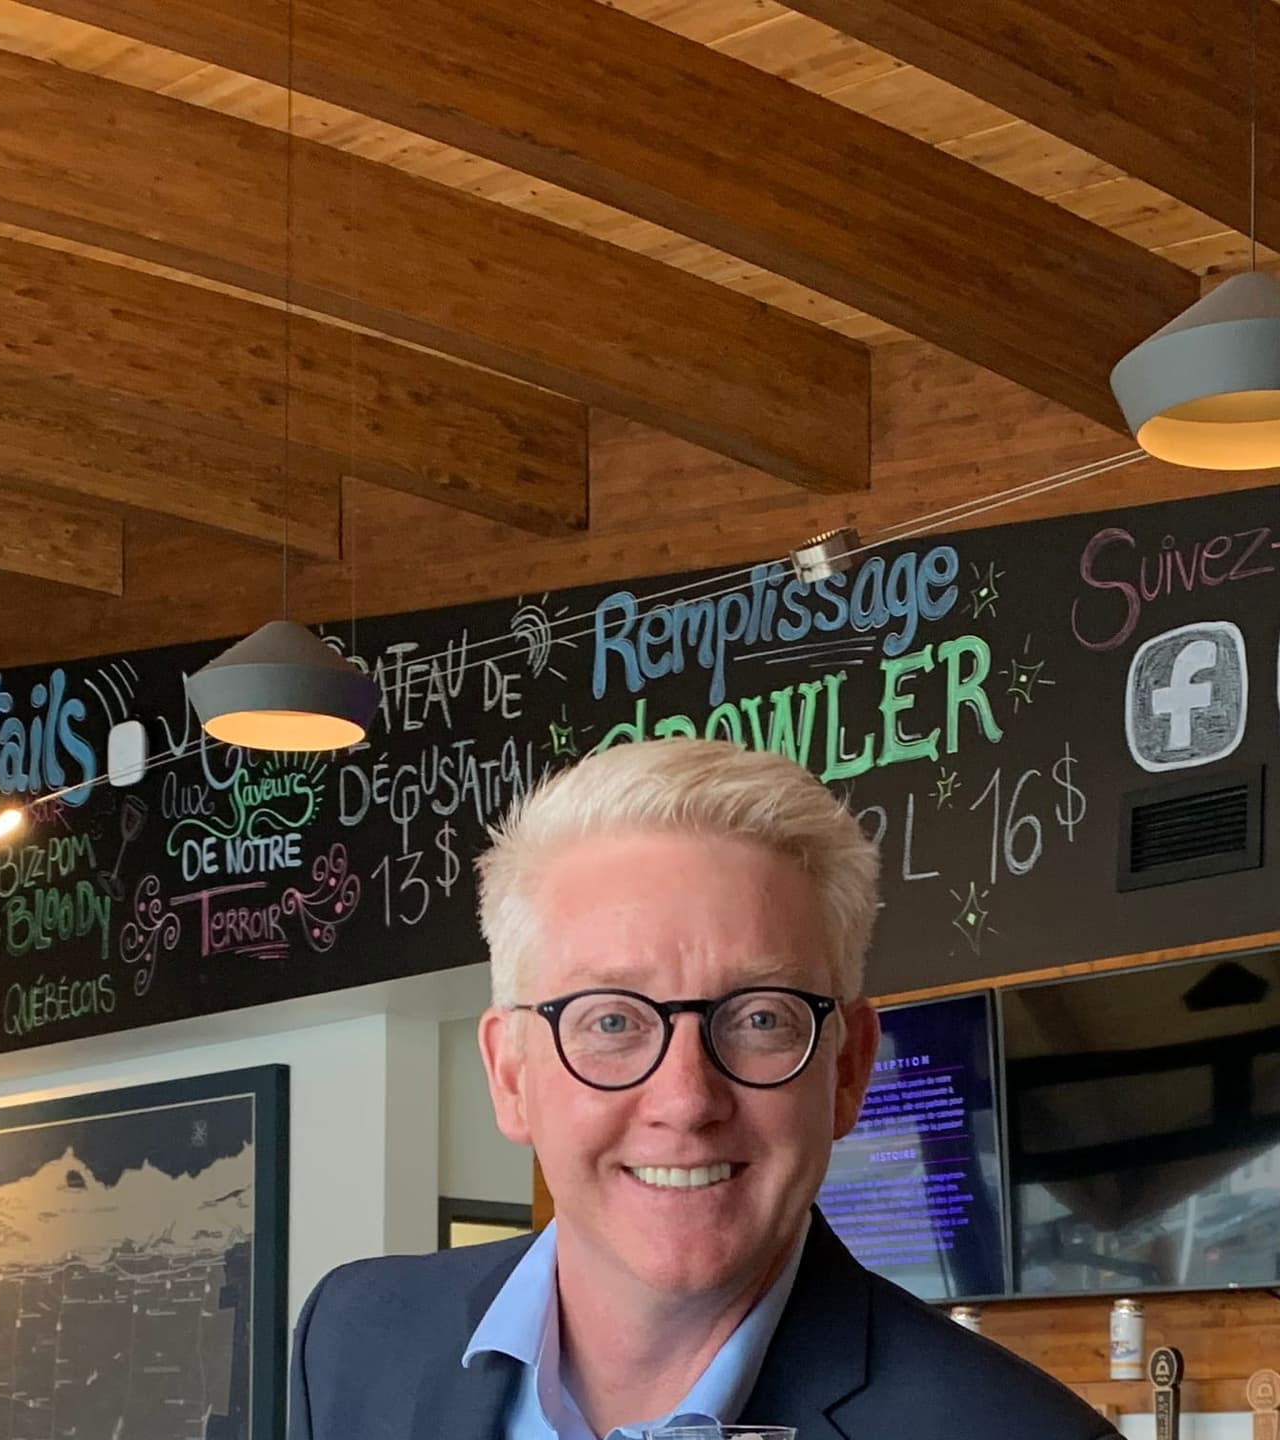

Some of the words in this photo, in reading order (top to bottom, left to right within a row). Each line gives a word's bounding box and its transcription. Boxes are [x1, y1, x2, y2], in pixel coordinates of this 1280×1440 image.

[591, 545, 960, 707] Remplissage
[483, 660, 523, 719] DE
[181, 837, 219, 882] DE
[225, 832, 304, 876] NOTRE
[6, 880, 111, 960] BLOODY
[874, 1055, 930, 1073] RIPTION
